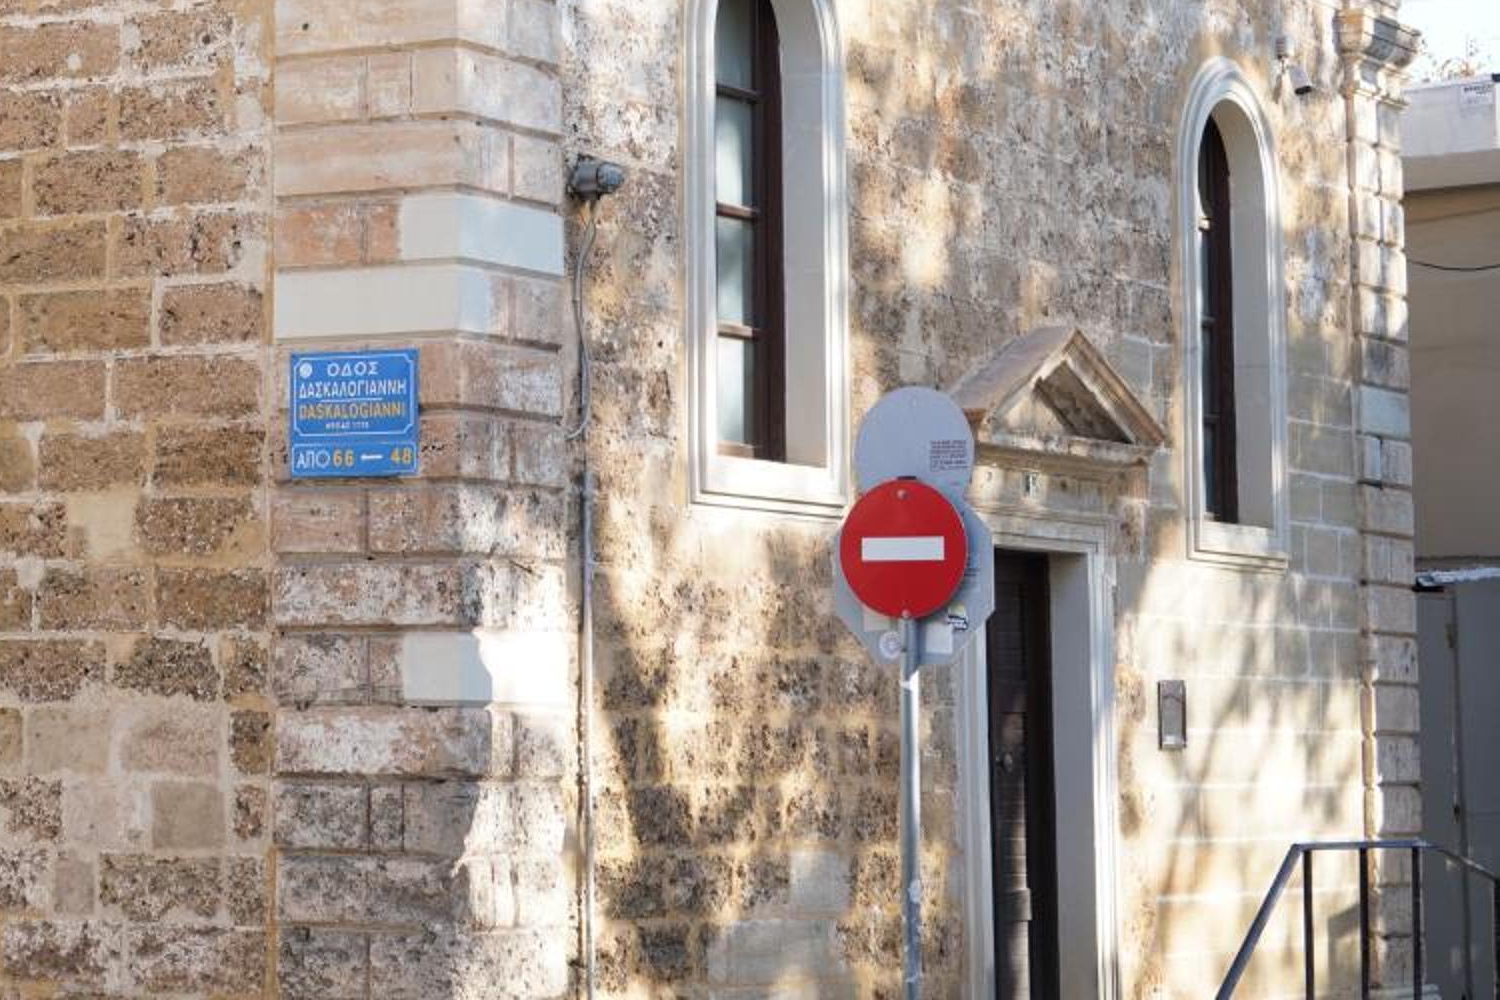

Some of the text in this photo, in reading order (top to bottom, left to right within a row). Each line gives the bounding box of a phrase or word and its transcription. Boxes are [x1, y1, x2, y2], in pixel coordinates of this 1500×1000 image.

[326, 361, 379, 377] ΟΔΟΣ
[298, 379, 408, 399] ΔΑΣΚΑΛΟΓΙΑΝΝΗ
[298, 401, 407, 421] DASKALOGIANNI
[295, 450, 331, 469] ΑΠΟ
[389, 446, 412, 465] 48
